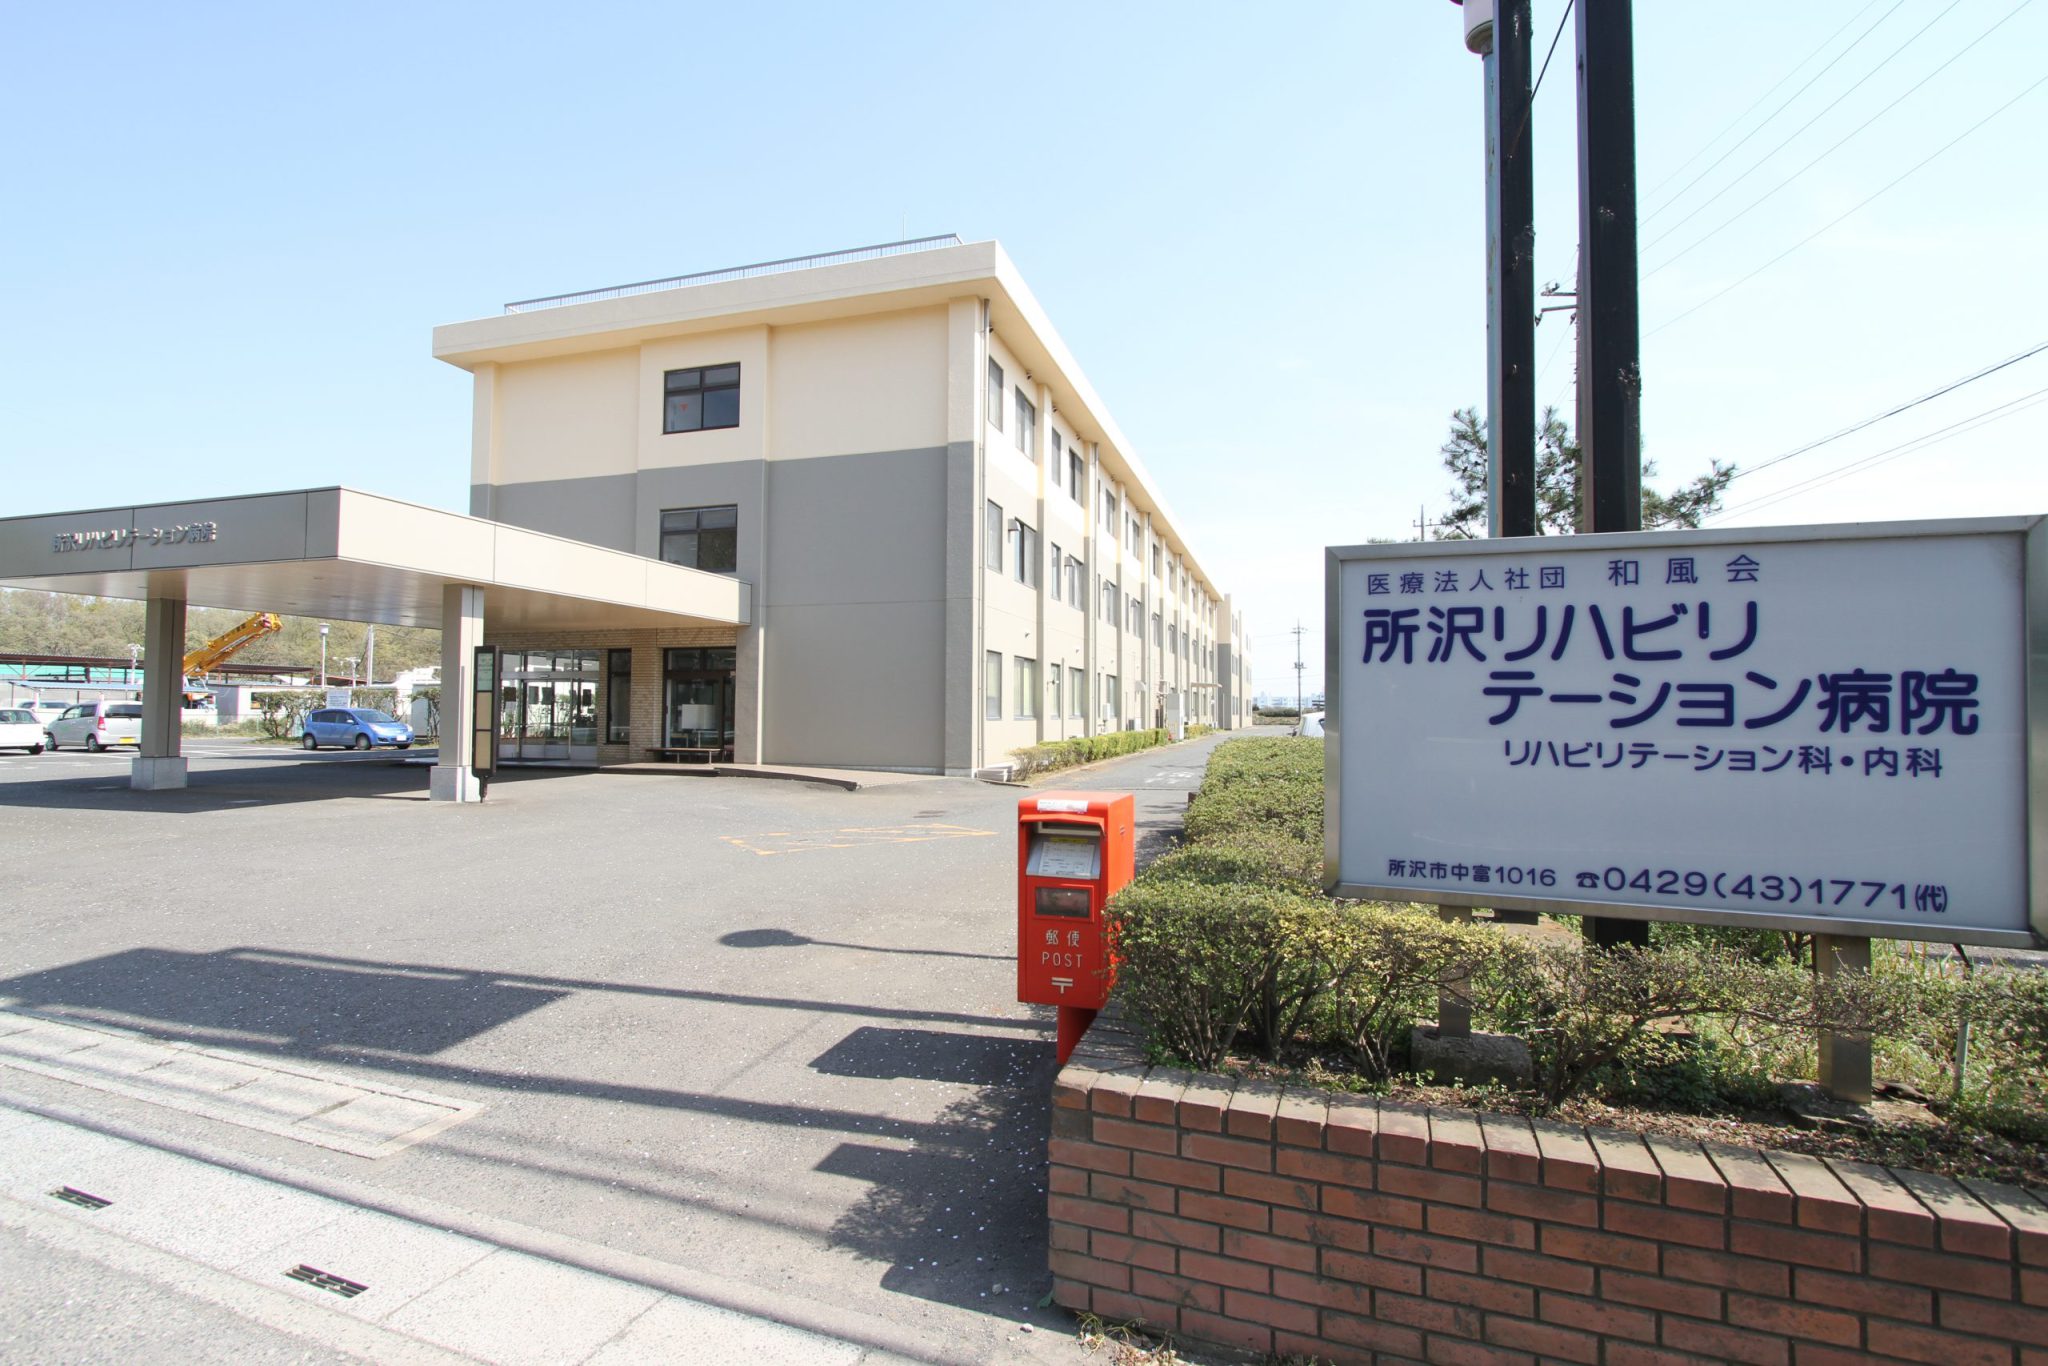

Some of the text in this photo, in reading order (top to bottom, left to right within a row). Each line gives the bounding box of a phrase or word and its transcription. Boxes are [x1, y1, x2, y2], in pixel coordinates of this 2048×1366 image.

[1366, 554, 1761, 596] 医療法人社団 和風会
[1362, 600, 1759, 665] 所沢リハビリ
[1482, 668, 1979, 736] テーション病院
[1504, 739, 1943, 779] リハビリテーション科・内科
[1388, 859, 1557, 888] 所沢市中富1016
[1046, 929, 1080, 948] 郵便
[1041, 951, 1083, 969] POST
